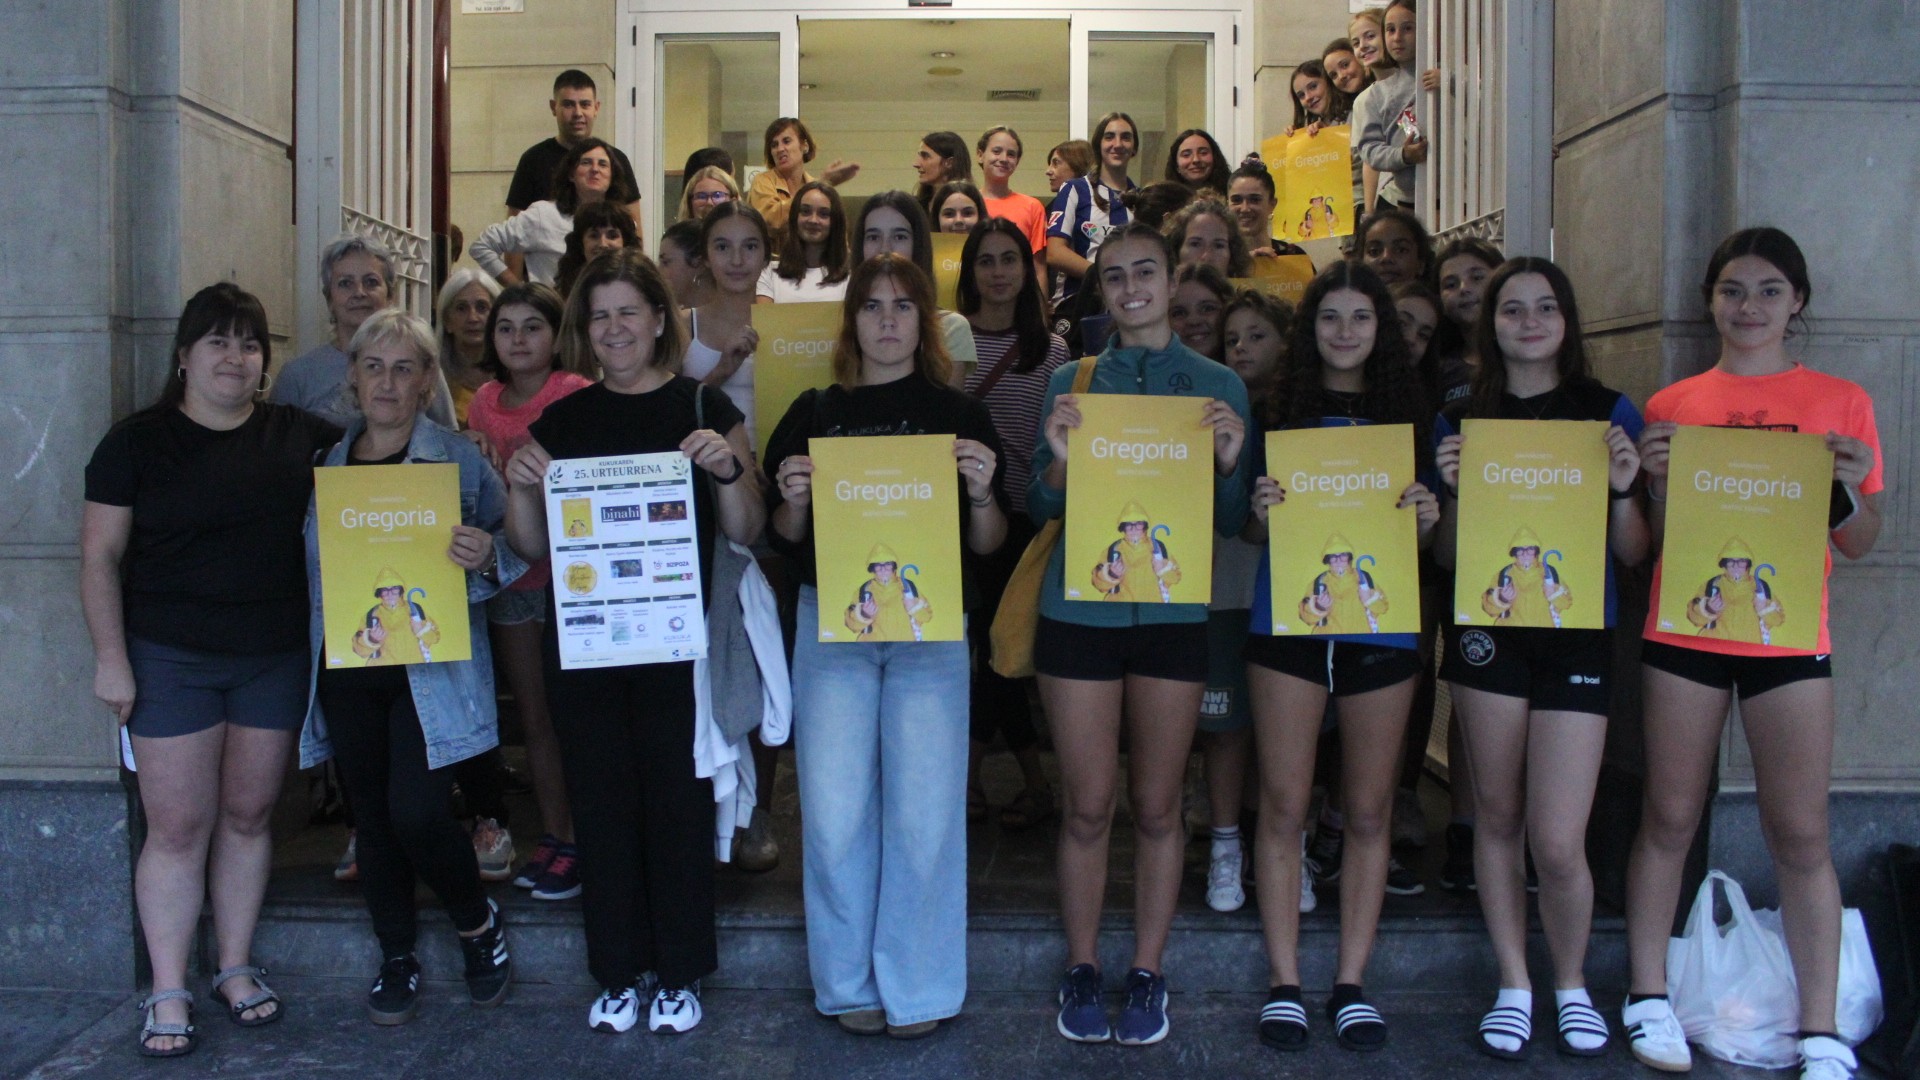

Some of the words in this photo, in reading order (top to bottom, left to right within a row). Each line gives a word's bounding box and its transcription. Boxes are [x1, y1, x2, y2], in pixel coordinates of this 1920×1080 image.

[1295, 151, 1339, 168] Gregoria
[942, 259, 962, 271] Gr
[848, 425, 892, 436] KUKUKA
[1091, 437, 1188, 465] Gregoria
[574, 469, 589, 479] 25.
[591, 465, 662, 478] URTEURRENA
[1291, 468, 1390, 496] Gregoria
[1483, 463, 1582, 489] Gregoria
[835, 478, 933, 506] Gregoria
[1694, 470, 1803, 500] Gregoria
[341, 505, 437, 531] Gregoria
[602, 506, 640, 520] binahi
[1203, 691, 1230, 703] AWL
